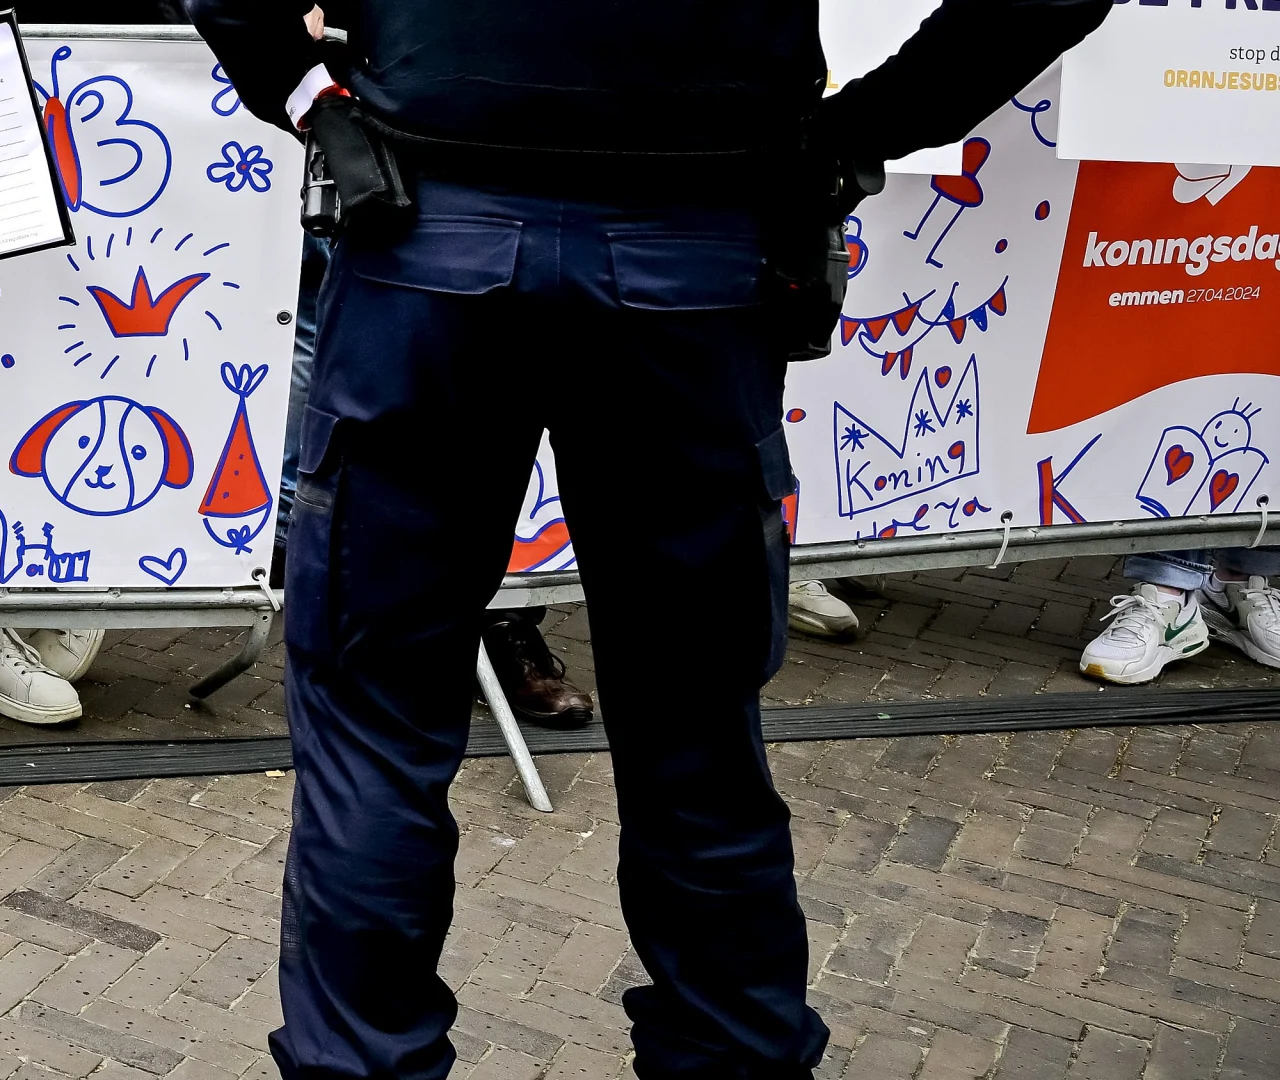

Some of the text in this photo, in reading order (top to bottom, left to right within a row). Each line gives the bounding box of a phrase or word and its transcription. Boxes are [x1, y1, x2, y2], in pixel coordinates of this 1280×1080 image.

[1229, 46, 1267, 65] stop
[1163, 69, 1280, 91] ORANJESUB
[1082, 225, 1280, 277] koningsda
[1108, 285, 1261, 307] emmen 27.04.2024
[846, 440, 966, 520] Koning
